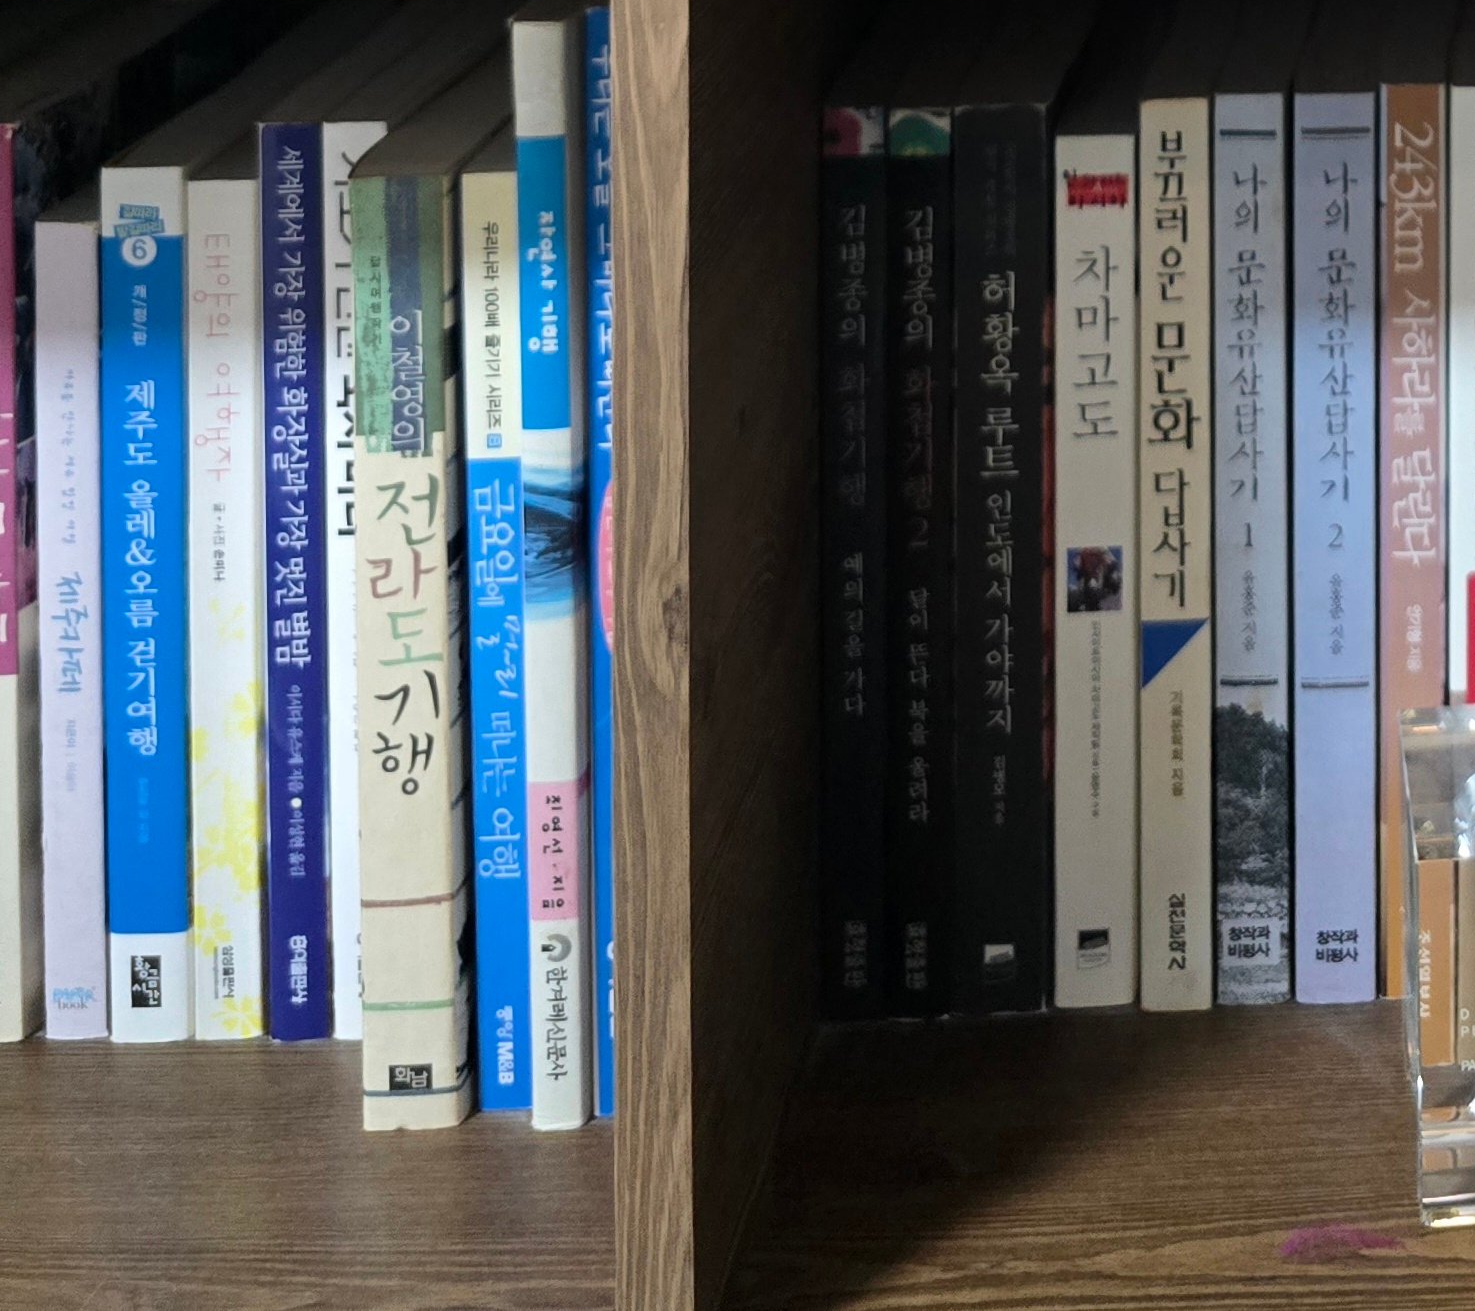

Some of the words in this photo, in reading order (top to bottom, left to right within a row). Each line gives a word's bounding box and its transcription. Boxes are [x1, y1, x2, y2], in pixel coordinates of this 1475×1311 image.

[274, 144, 305, 243] 세계에서
[1152, 129, 1189, 303] 부끄러운
[1232, 161, 1267, 235] 나의
[1322, 161, 1358, 235] 나의
[1392, 121, 1437, 273] 243km
[274, 251, 306, 300] 가장
[483, 221, 501, 281] 우리나라
[274, 308, 307, 382] 위험한
[981, 270, 1019, 396] 허황옥
[1073, 244, 1120, 441] 차마고도
[1228, 248, 1265, 503] 문화유산답사기
[1318, 248, 1357, 502] 문화유산답사기
[1391, 289, 1436, 437] 사하라를
[124, 379, 158, 467] 제주도
[1147, 320, 1201, 451] 문화
[272, 387, 310, 496] 화장실과
[980, 407, 1020, 479] 루트
[274, 500, 310, 550] 가장
[474, 481, 517, 607] 금요일에
[1152, 466, 1191, 610] 답사기
[1328, 522, 1344, 549] 2
[1391, 446, 1435, 567] 달린다
[274, 557, 310, 606] 멋진
[367, 472, 444, 667] 전라도
[274, 612, 312, 669] 별밤
[984, 617, 1015, 735] 가야까지
[372, 669, 441, 796] 기행
[481, 711, 517, 797] 떠나는
[480, 807, 521, 879] 여행
[1227, 943, 1271, 959] 비평사
[1228, 925, 1271, 942] 창작과
[1315, 946, 1359, 963] 비평사
[1316, 929, 1359, 946] 창작과
[545, 965, 568, 1083] 한겨레신문사
